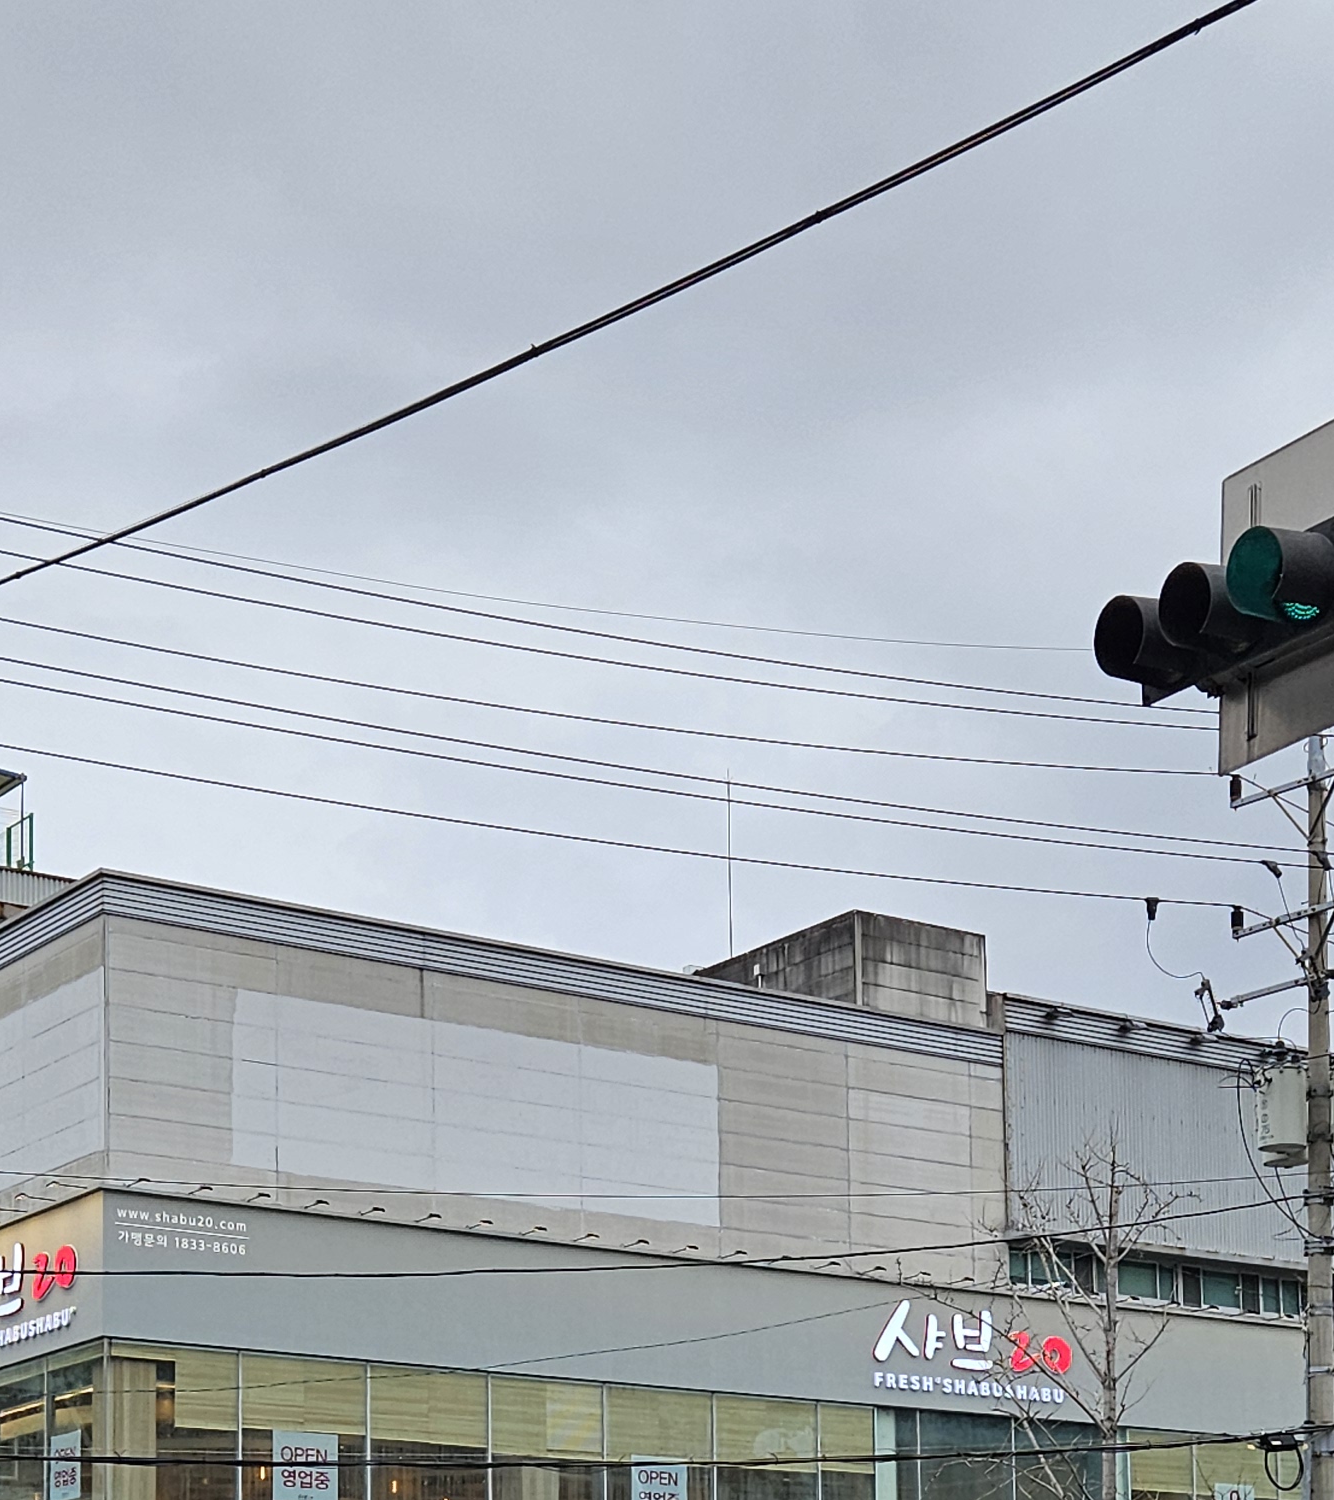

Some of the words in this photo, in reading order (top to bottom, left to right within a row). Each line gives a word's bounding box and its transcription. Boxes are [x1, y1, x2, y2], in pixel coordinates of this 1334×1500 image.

[116, 1207, 247, 1232] www.shabu20.com
[118, 1230, 168, 1248] 가맹문의
[174, 1237, 246, 1256] 1833-8606
[280, 1469, 330, 1490] 영업중
[638, 1469, 678, 1487] OPEN
